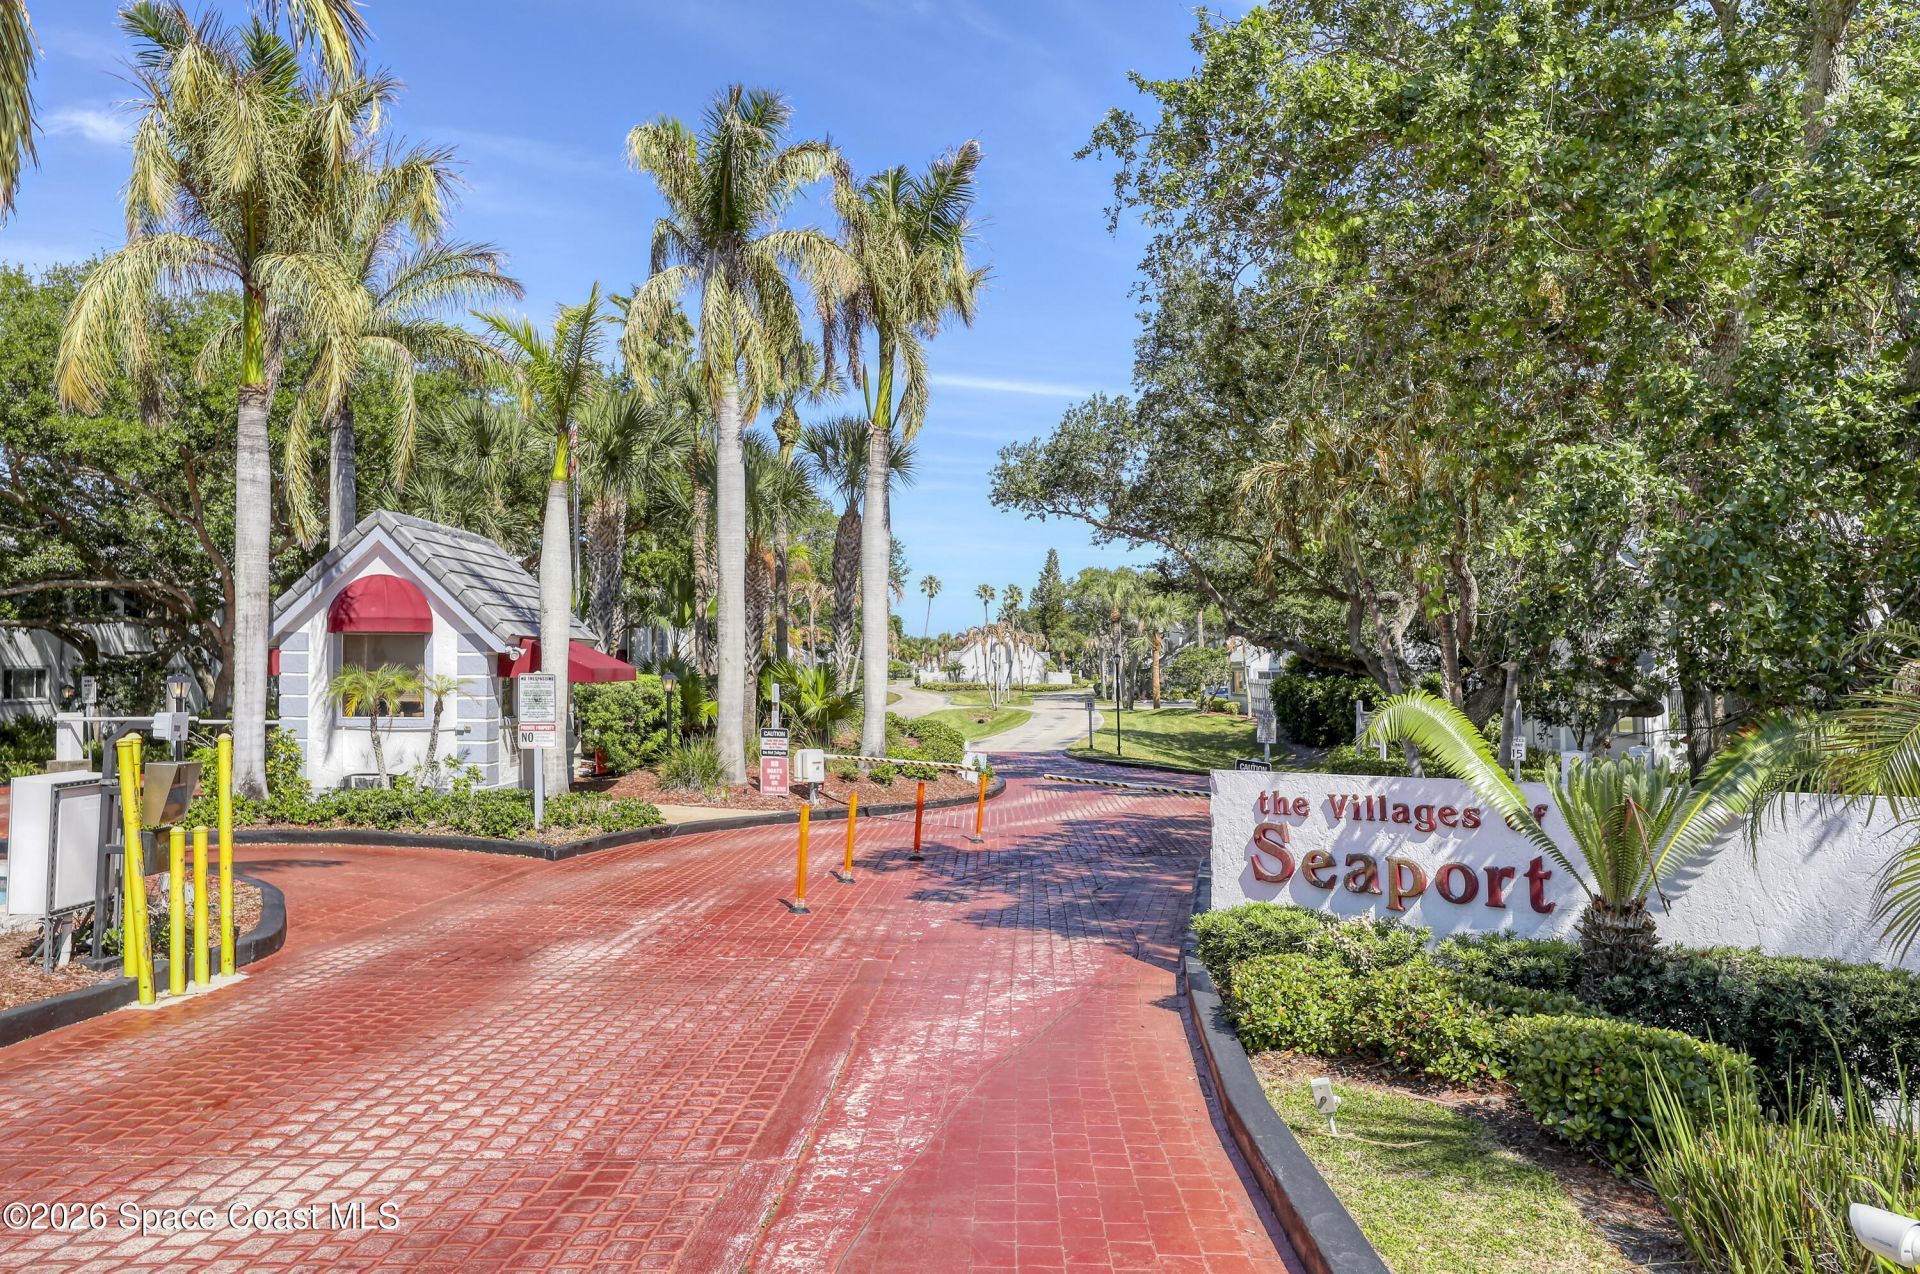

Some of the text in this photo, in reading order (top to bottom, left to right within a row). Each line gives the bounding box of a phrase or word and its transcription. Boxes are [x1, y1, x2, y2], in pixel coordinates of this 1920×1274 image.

[521, 732, 533, 742] NO
[1512, 749, 1523, 759] 15
[1258, 789, 1310, 818] the
[1328, 794, 1482, 832] Villages
[1250, 822, 1556, 913] Seaport
